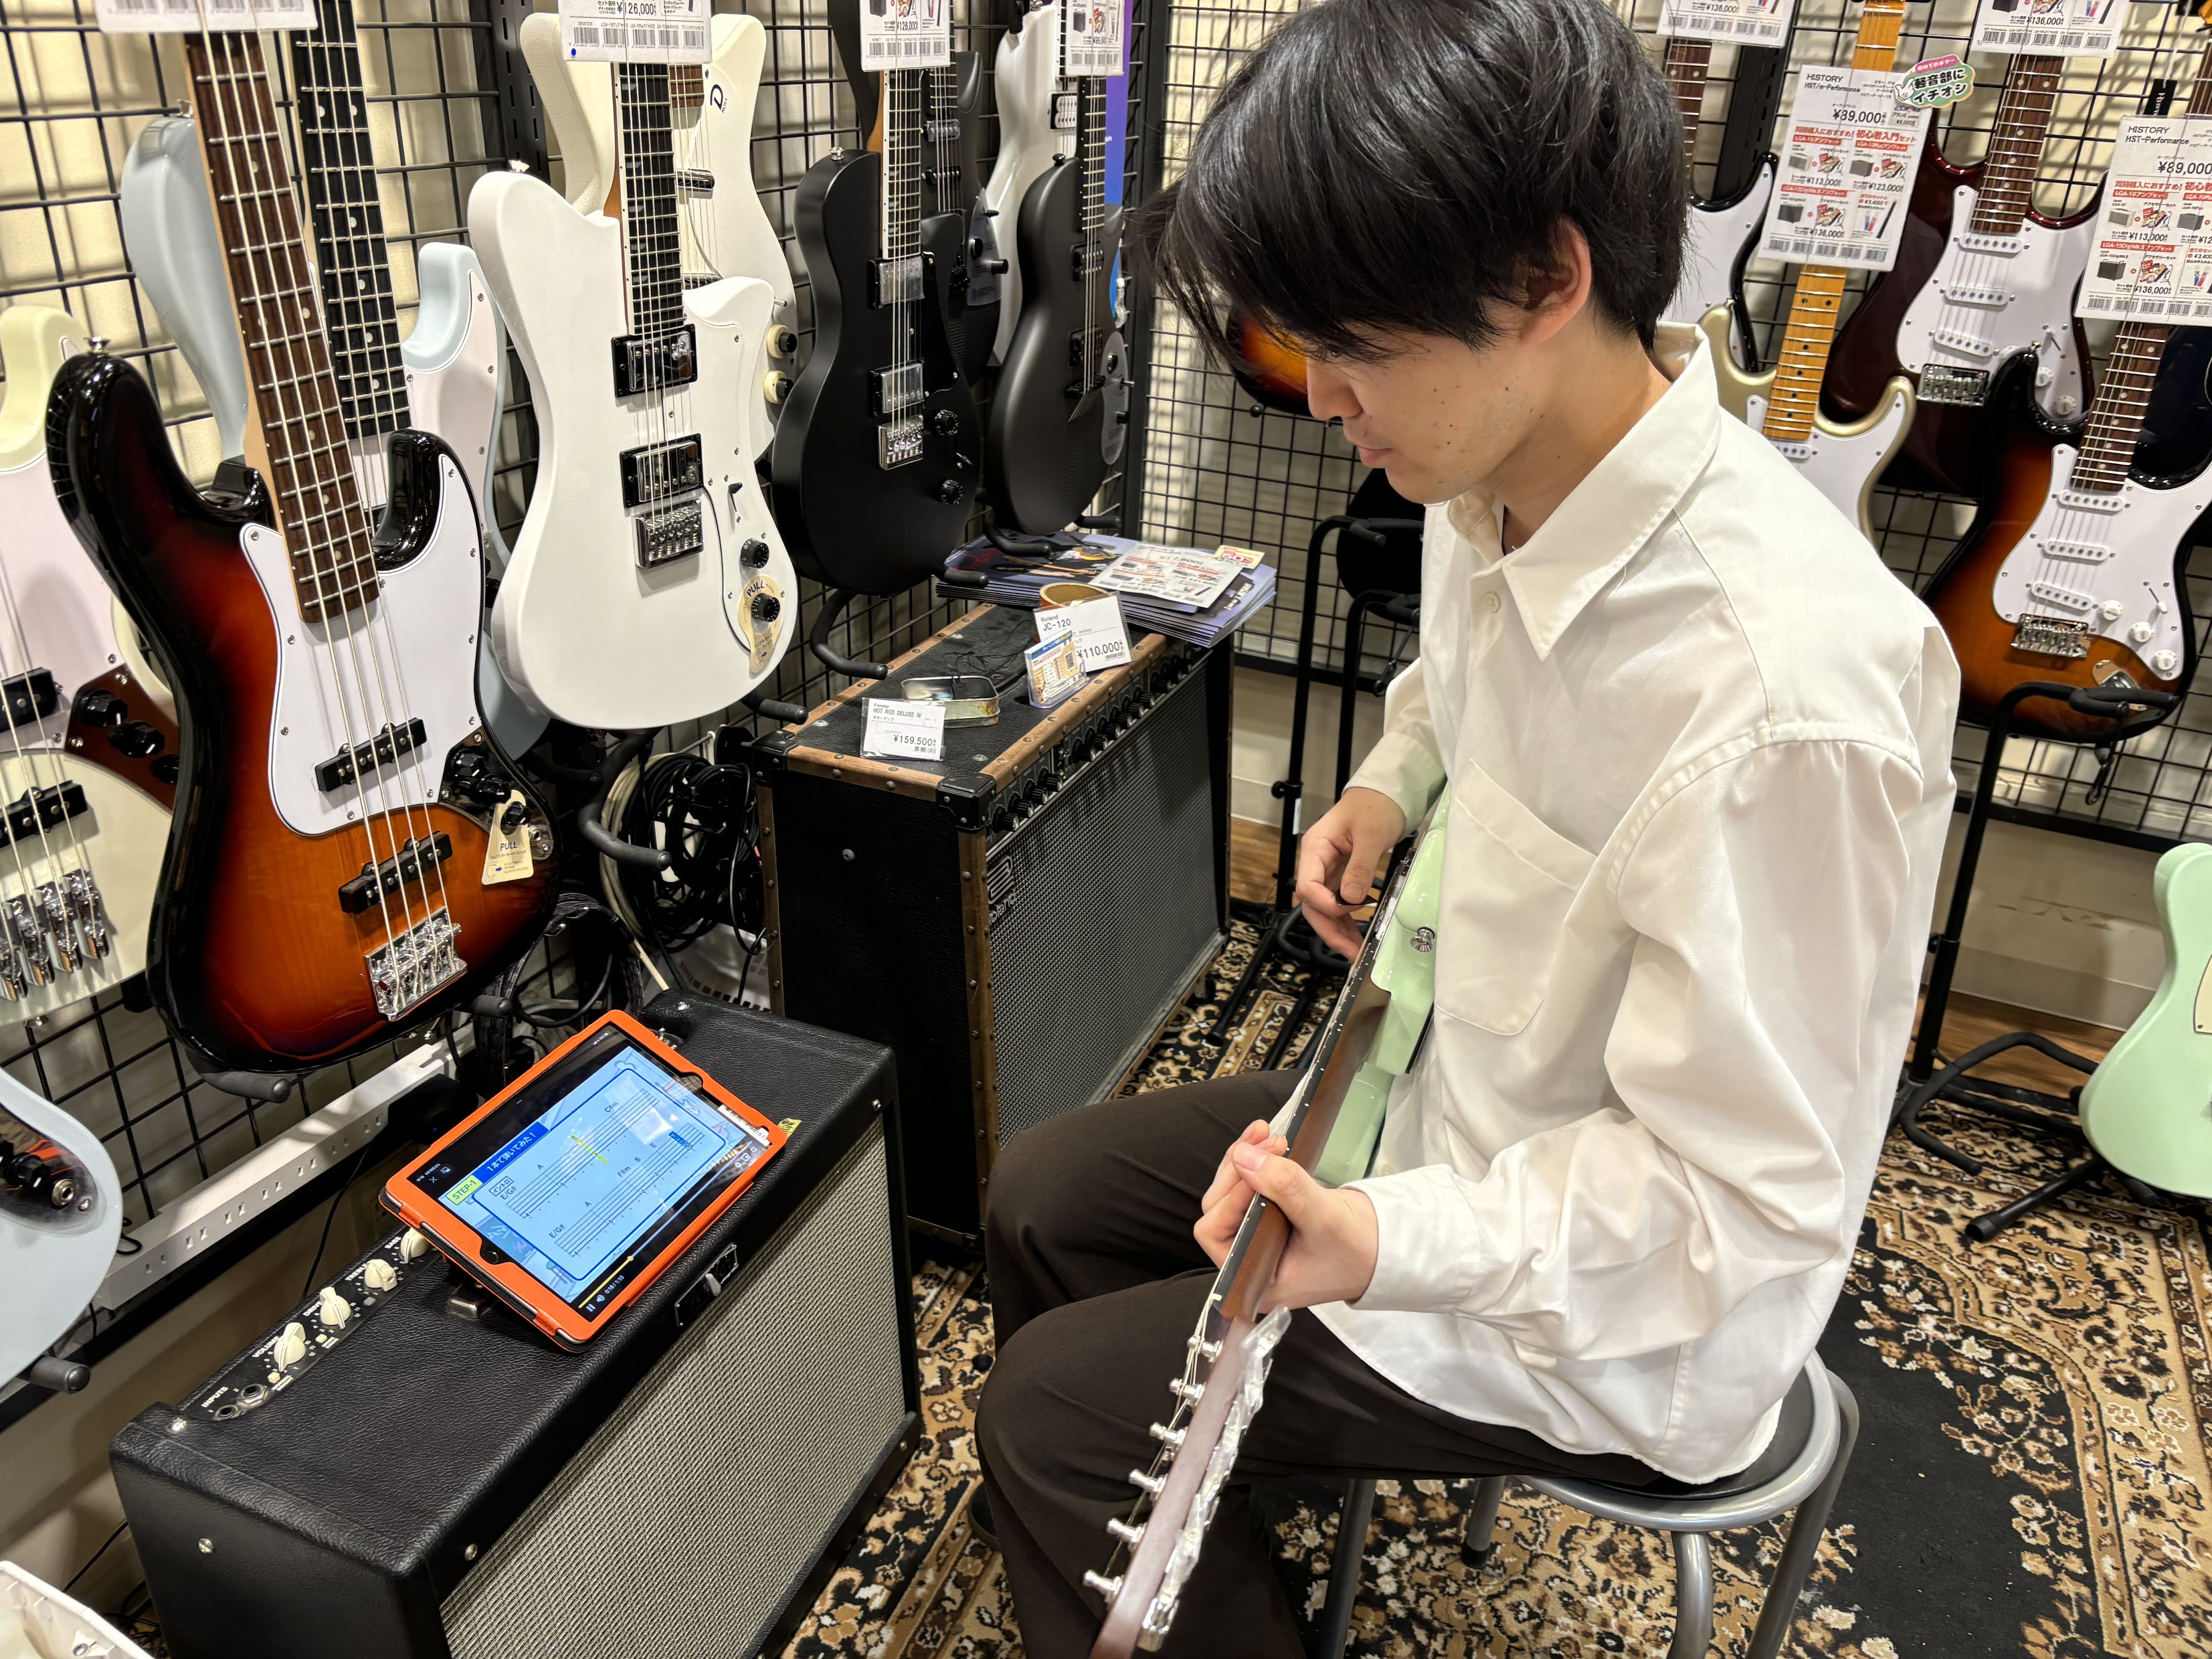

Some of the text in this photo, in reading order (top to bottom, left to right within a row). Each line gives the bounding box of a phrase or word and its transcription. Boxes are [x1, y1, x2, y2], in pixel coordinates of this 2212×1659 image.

[617, 2, 654, 15] ¥126,000
[1807, 73, 1843, 82] HISTORY
[1915, 69, 1964, 89] 軽音部に
[1914, 84, 1966, 102] イチオシ
[2125, 136, 2189, 144] HST-Performance
[2157, 161, 2212, 175] ¥89,000
[2129, 232, 2165, 241] ¥113,000
[747, 580, 764, 597] PULL
[1043, 618, 1071, 631] JC-120
[1077, 641, 1120, 658] ¥110,000
[893, 734, 933, 746] ¥159,500
[500, 841, 517, 851] PULL
[989, 888, 1016, 925] oland
[452, 1180, 477, 1200] STEP-1
[493, 1179, 510, 1193] イントロ
[501, 1186, 517, 1200] E/G#
[549, 1224, 565, 1239] E/G#
[384, 1236, 401, 1249] BASS
[303, 1301, 322, 1317] DRIVE
[252, 1336, 280, 1357] VOLUME
[201, 1386, 228, 1408] INPUTS
